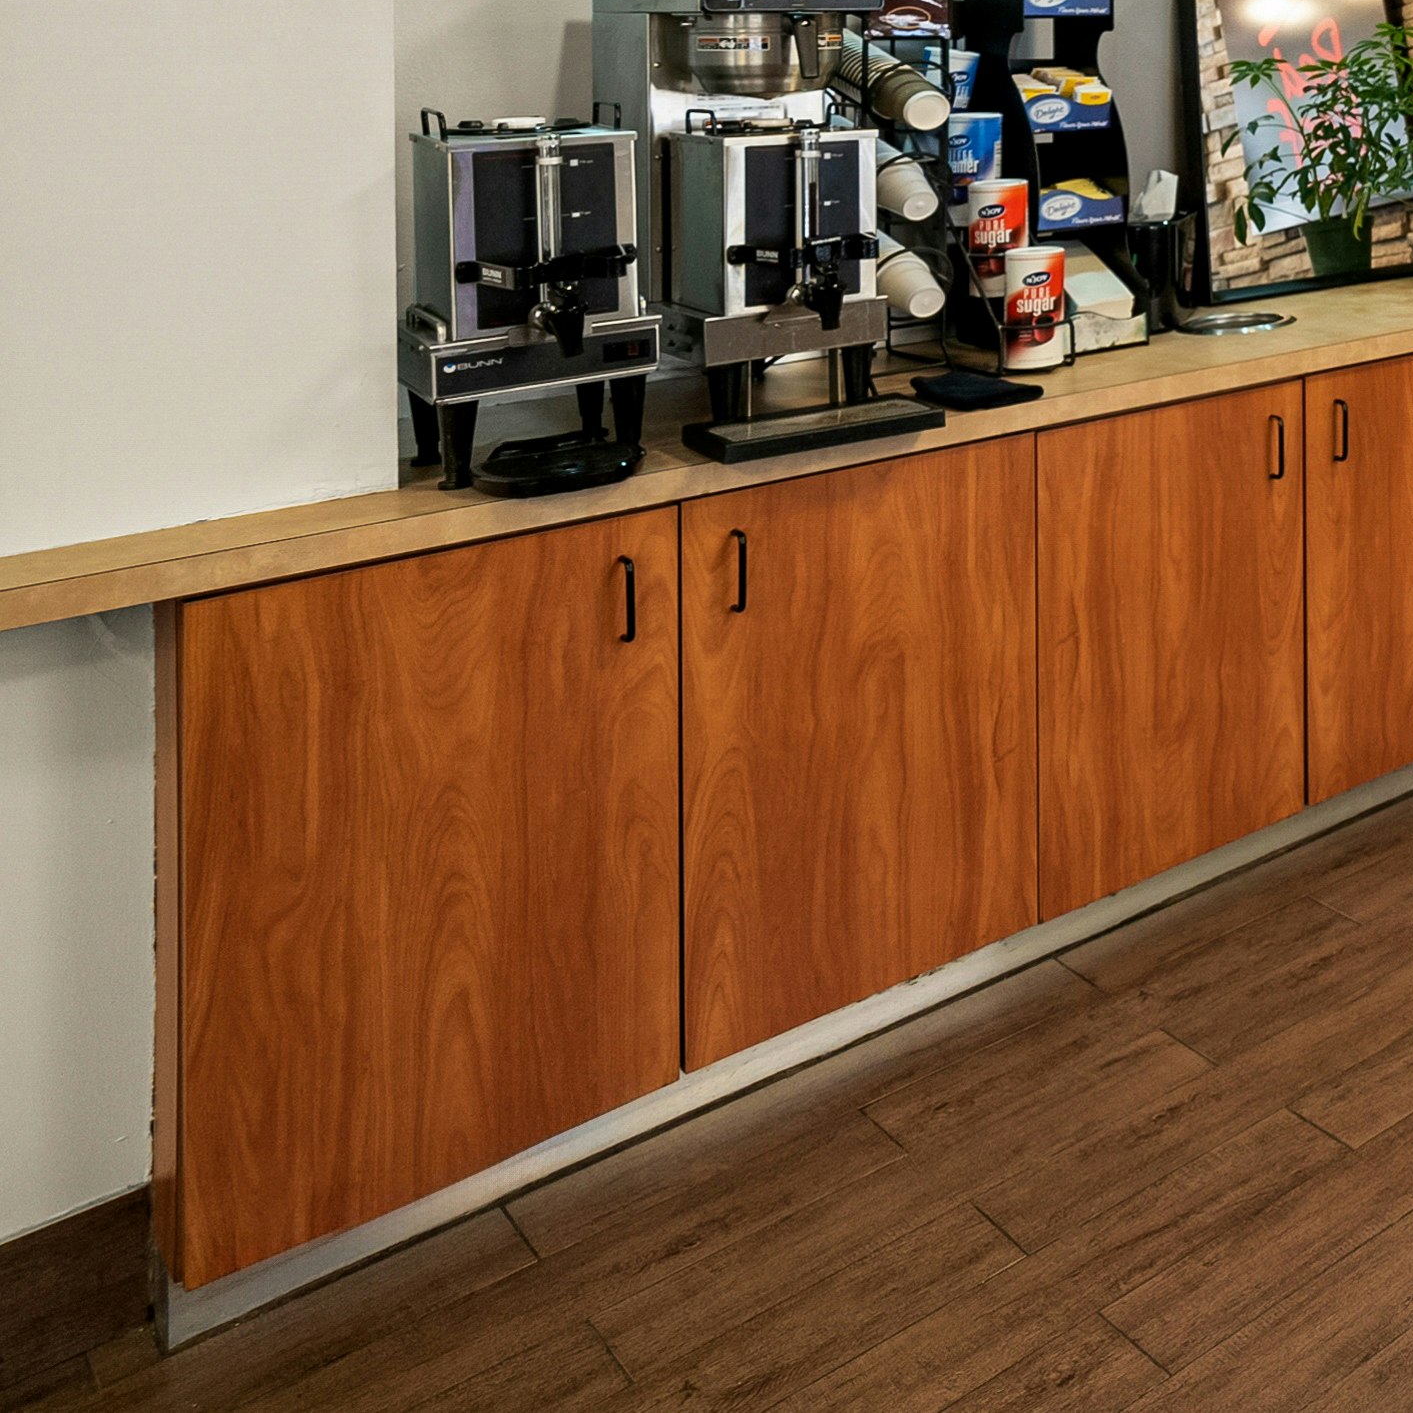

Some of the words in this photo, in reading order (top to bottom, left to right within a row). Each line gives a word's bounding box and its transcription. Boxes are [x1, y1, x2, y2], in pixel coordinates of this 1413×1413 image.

[979, 219, 1005, 231] PURE
[974, 229, 1012, 248] sugar
[1023, 286, 1050, 299] PURE
[1016, 296, 1056, 316] sugar
[457, 357, 504, 371] BUNN
